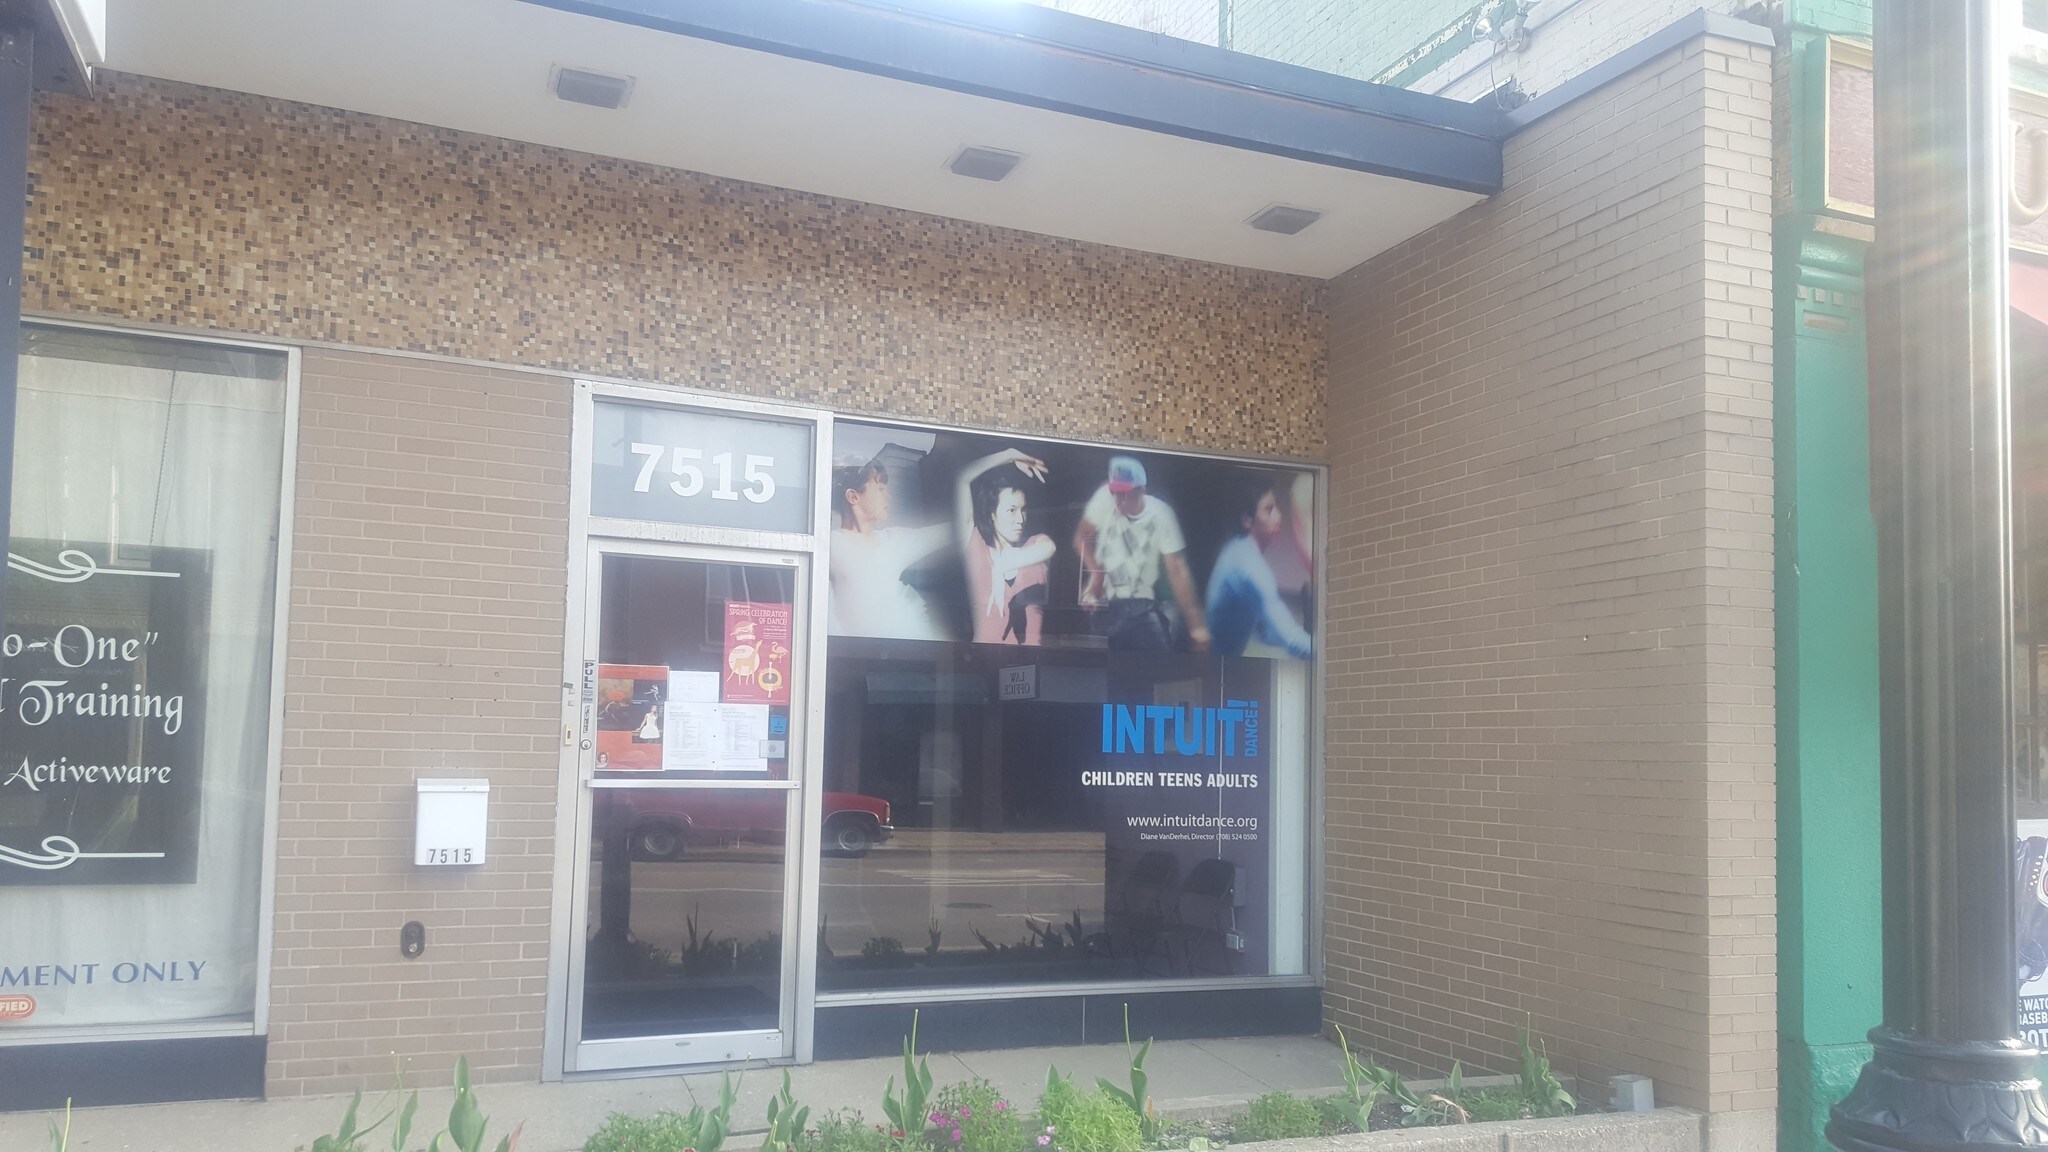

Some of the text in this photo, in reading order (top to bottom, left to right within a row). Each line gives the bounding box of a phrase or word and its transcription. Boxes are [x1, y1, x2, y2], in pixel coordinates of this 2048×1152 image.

[630, 442, 776, 504] 7515
[729, 608, 788, 618] SPRING CELEBRATION
[758, 617, 767, 625] OF
[583, 662, 594, 689] PULL
[19, 680, 183, 736] Training
[1102, 703, 1244, 757] INTUIT
[3, 756, 172, 792] Activeware
[1081, 771, 1259, 788] CHILDREN TEENS ADULTS
[1126, 813, 1258, 831] www.intuitdance.org
[429, 848, 472, 864] 7515
[112, 960, 207, 984] ONLY
